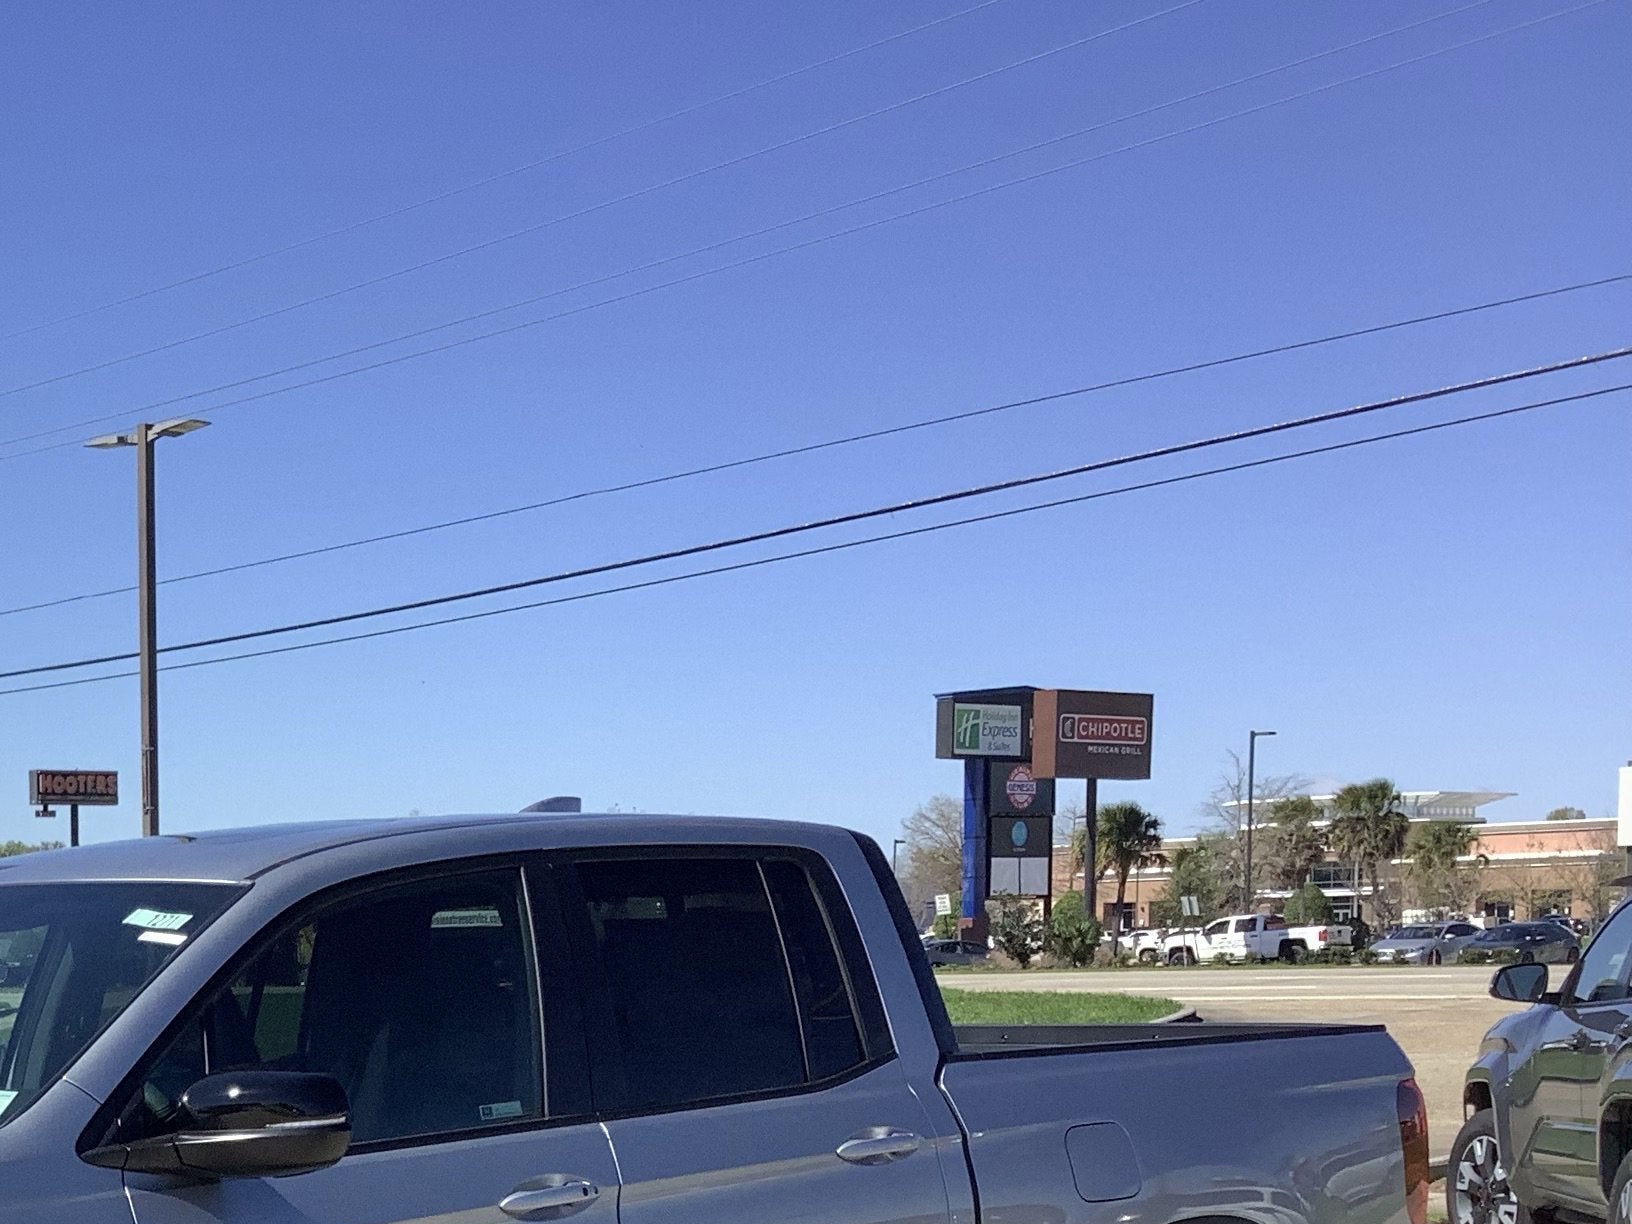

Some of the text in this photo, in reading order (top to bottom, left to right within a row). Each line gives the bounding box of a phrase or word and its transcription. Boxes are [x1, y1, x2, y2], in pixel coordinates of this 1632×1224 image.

[982, 721, 1018, 740] Express
[1079, 721, 1144, 738] CHIPOTLE
[1088, 745, 1142, 755] MEXICAN GRILL
[39, 774, 117, 794] HOOTERS
